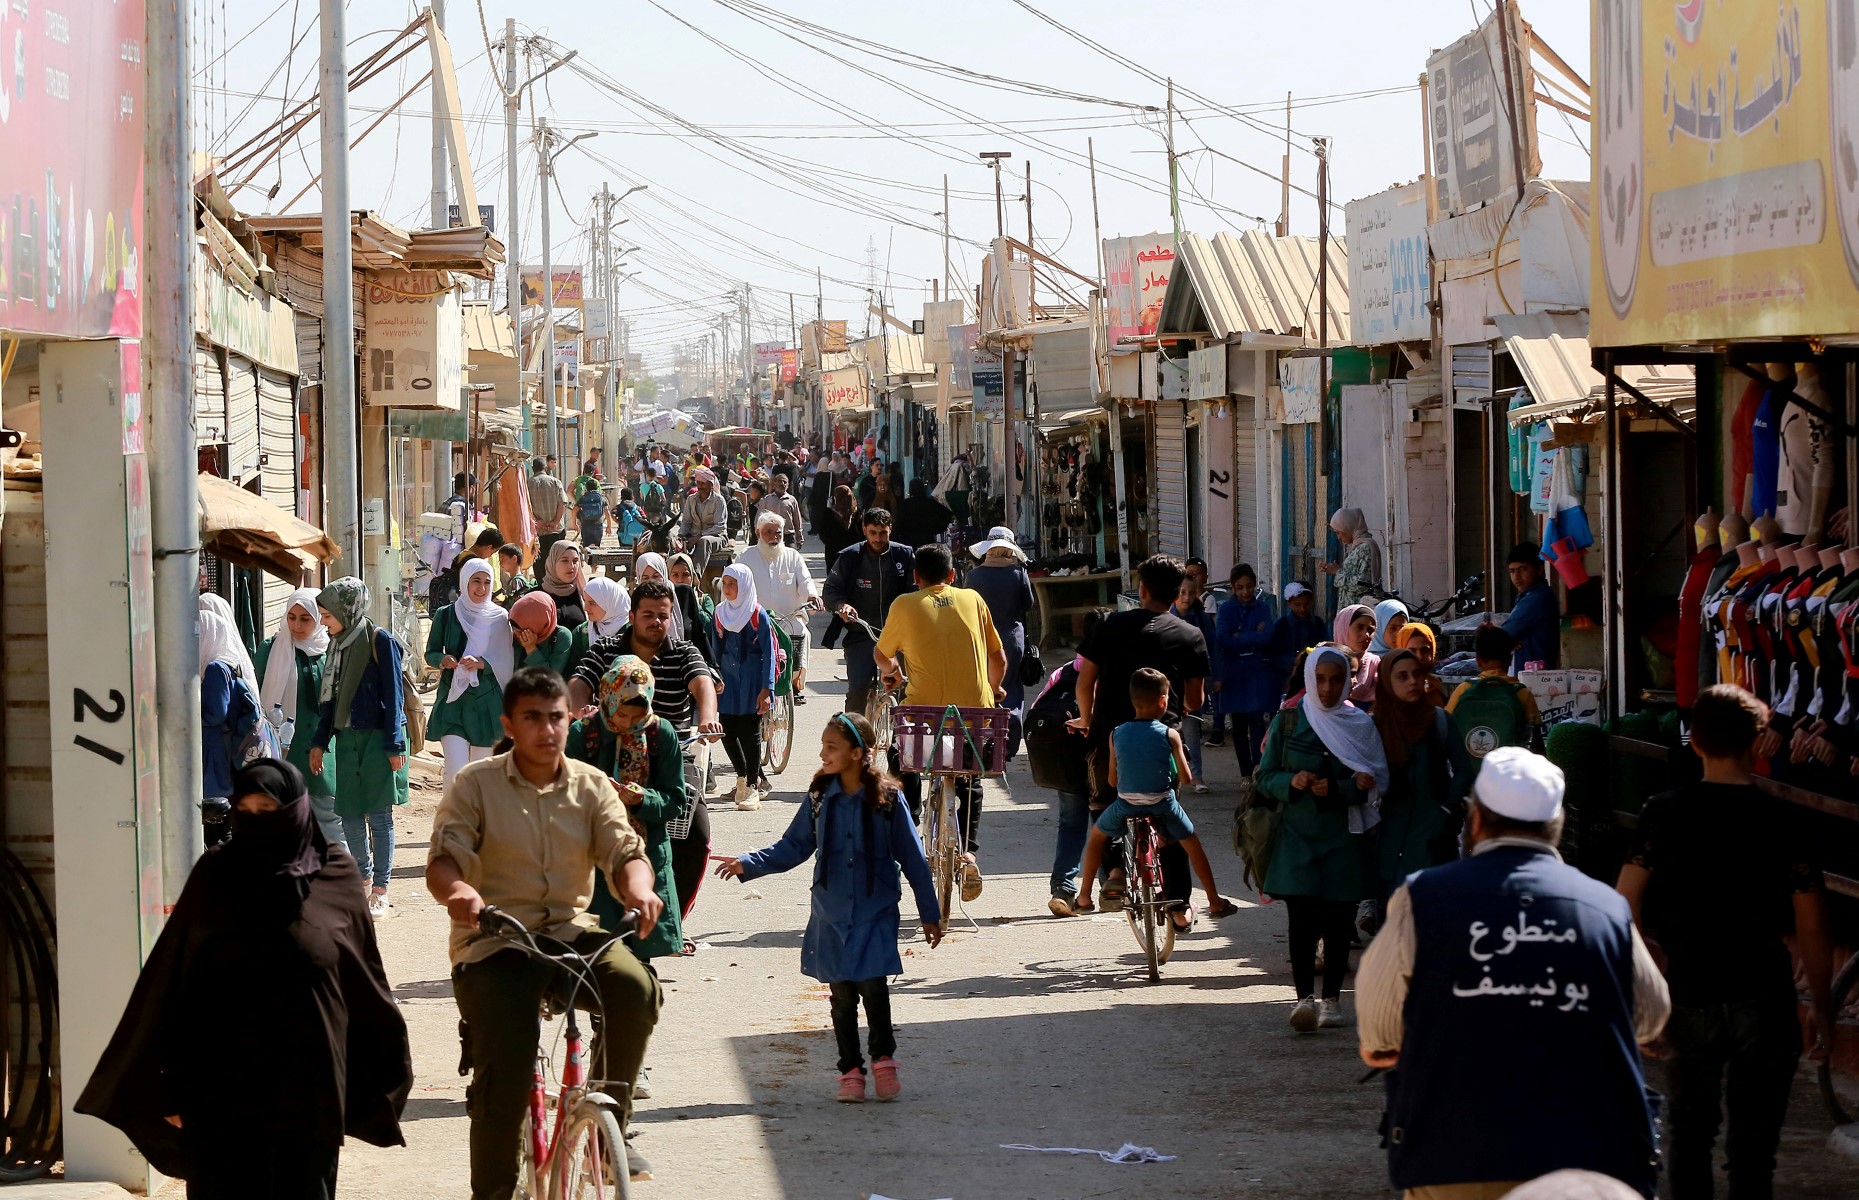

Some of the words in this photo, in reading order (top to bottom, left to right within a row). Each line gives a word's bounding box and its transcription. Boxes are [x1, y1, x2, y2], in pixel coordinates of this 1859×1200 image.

[1136, 245, 1175, 270] طعم
[1140, 271, 1169, 292] مار
[826, 386, 846, 407] هواوي
[845, 385, 859, 404] برج
[932, 595, 954, 609] PARIS
[1541, 700, 1575, 723] المده
[1469, 909, 1578, 962] متطوع
[1452, 965, 1590, 1013] يونيسف
